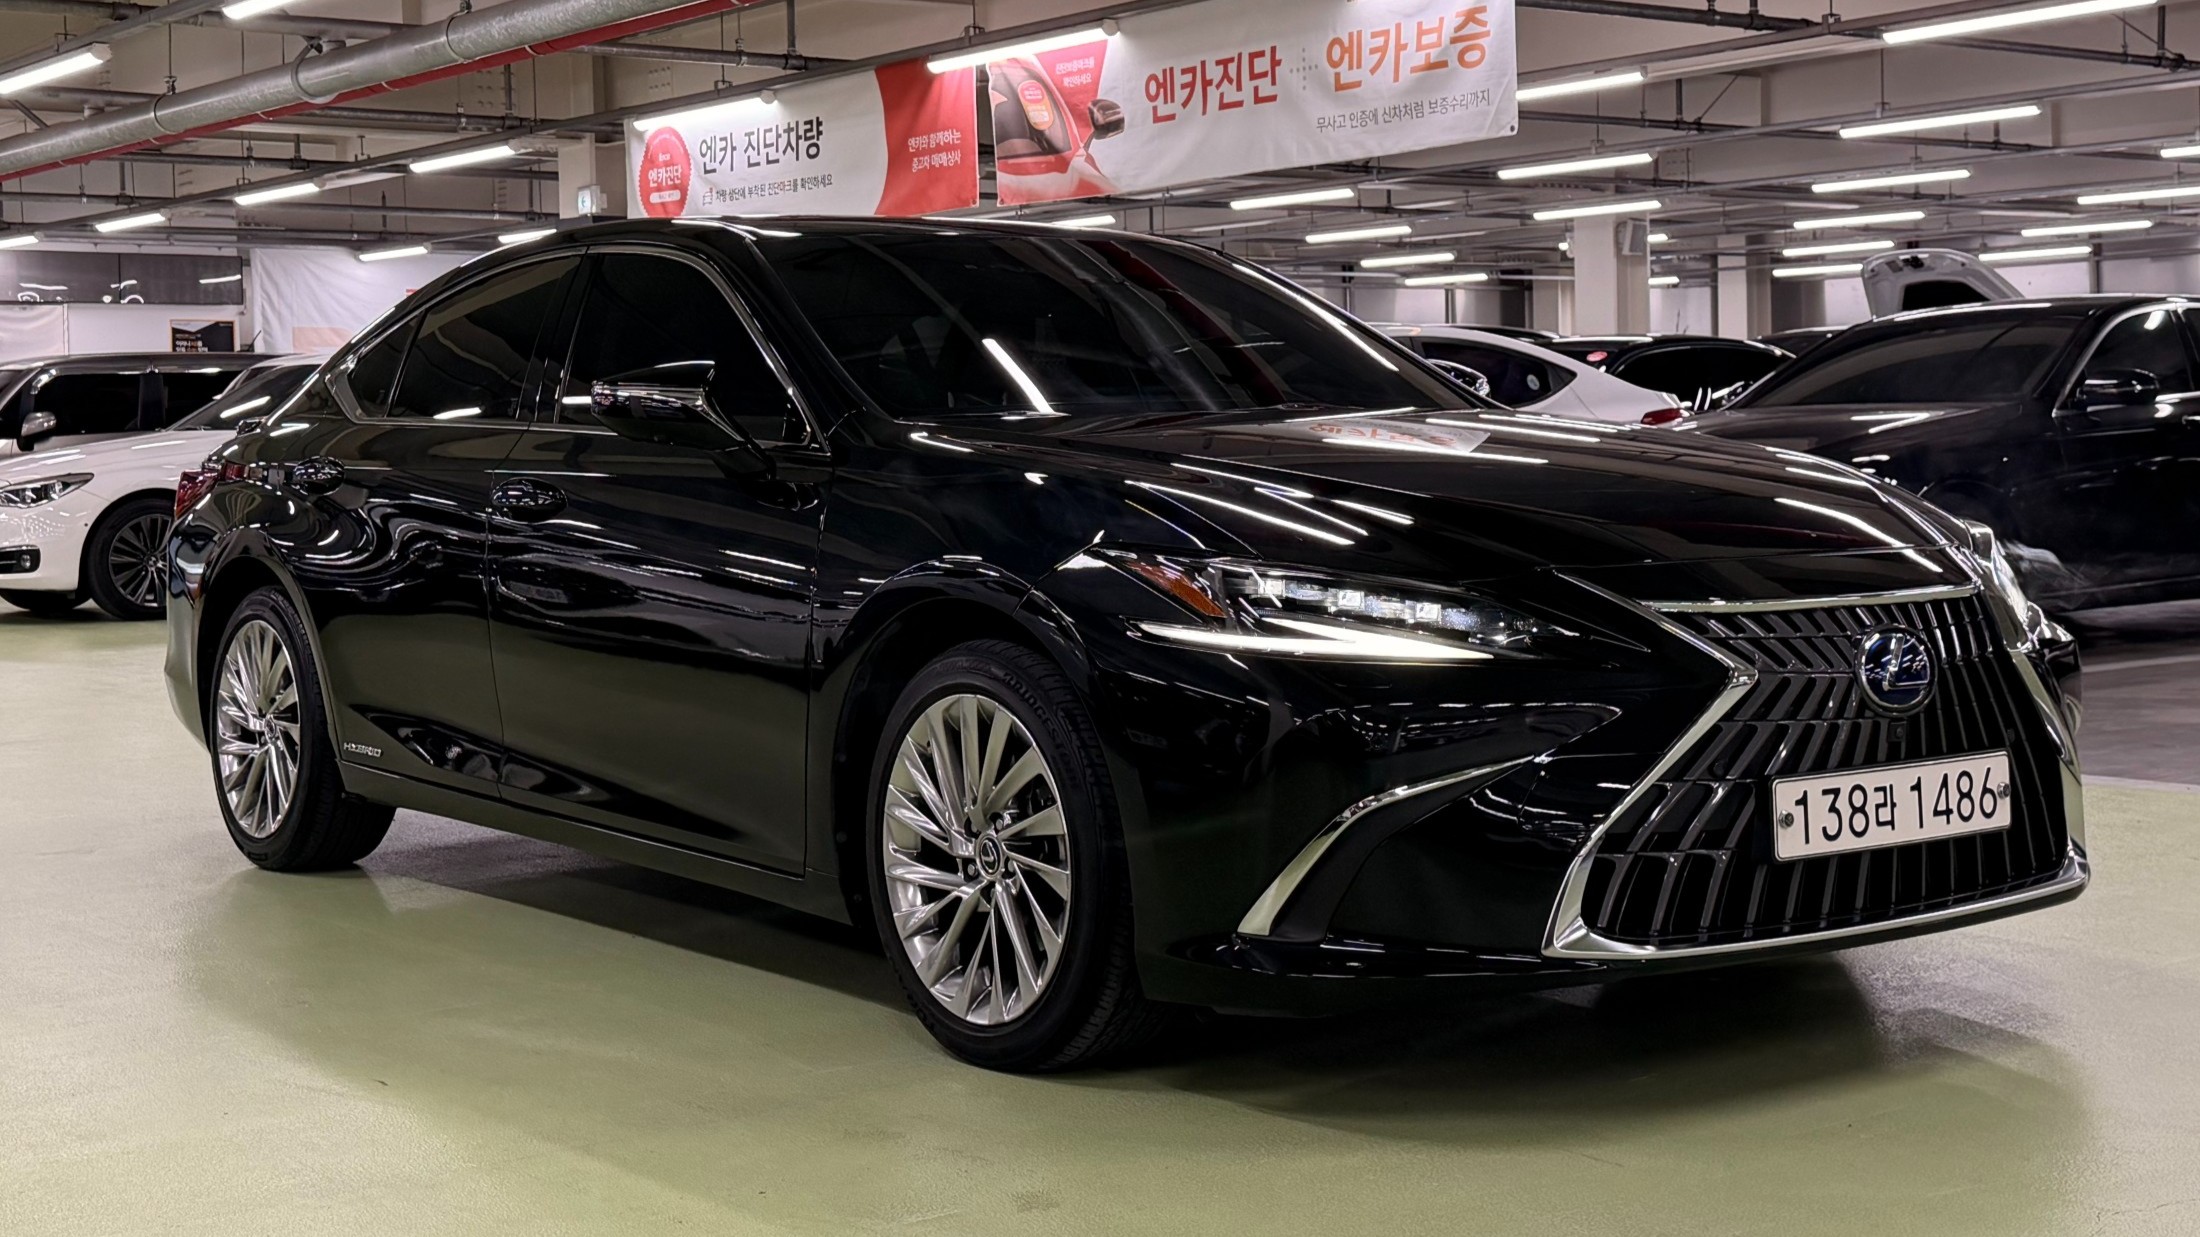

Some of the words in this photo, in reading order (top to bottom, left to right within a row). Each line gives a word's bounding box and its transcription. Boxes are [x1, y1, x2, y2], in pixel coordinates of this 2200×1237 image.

[1326, 5, 1491, 92] 엔카보증
[1144, 45, 1282, 124] 엔카진단
[1316, 115, 1346, 133] 무사고
[1349, 107, 1379, 129] 인증에
[1381, 101, 1425, 124] 신차처럼
[1428, 88, 1490, 115] 보증수리까지
[699, 132, 737, 174] 엔카
[744, 116, 823, 168] 진단차량
[908, 135, 928, 152] 엔카와
[930, 129, 961, 148] 함께하는
[648, 164, 682, 188] 엔카진단
[912, 155, 930, 172] 중고차
[931, 149, 961, 168] 매매상사
[716, 189, 727, 203] 차량
[728, 186, 746, 202] 상단에
[748, 184, 765, 198] 부착된
[768, 179, 798, 196] 진단마크를
[800, 174, 833, 191] 확인하세요
[343, 742, 382, 758] HYBRID
[1794, 783, 1897, 845] 138라
[1909, 767, 1998, 830] 1486
